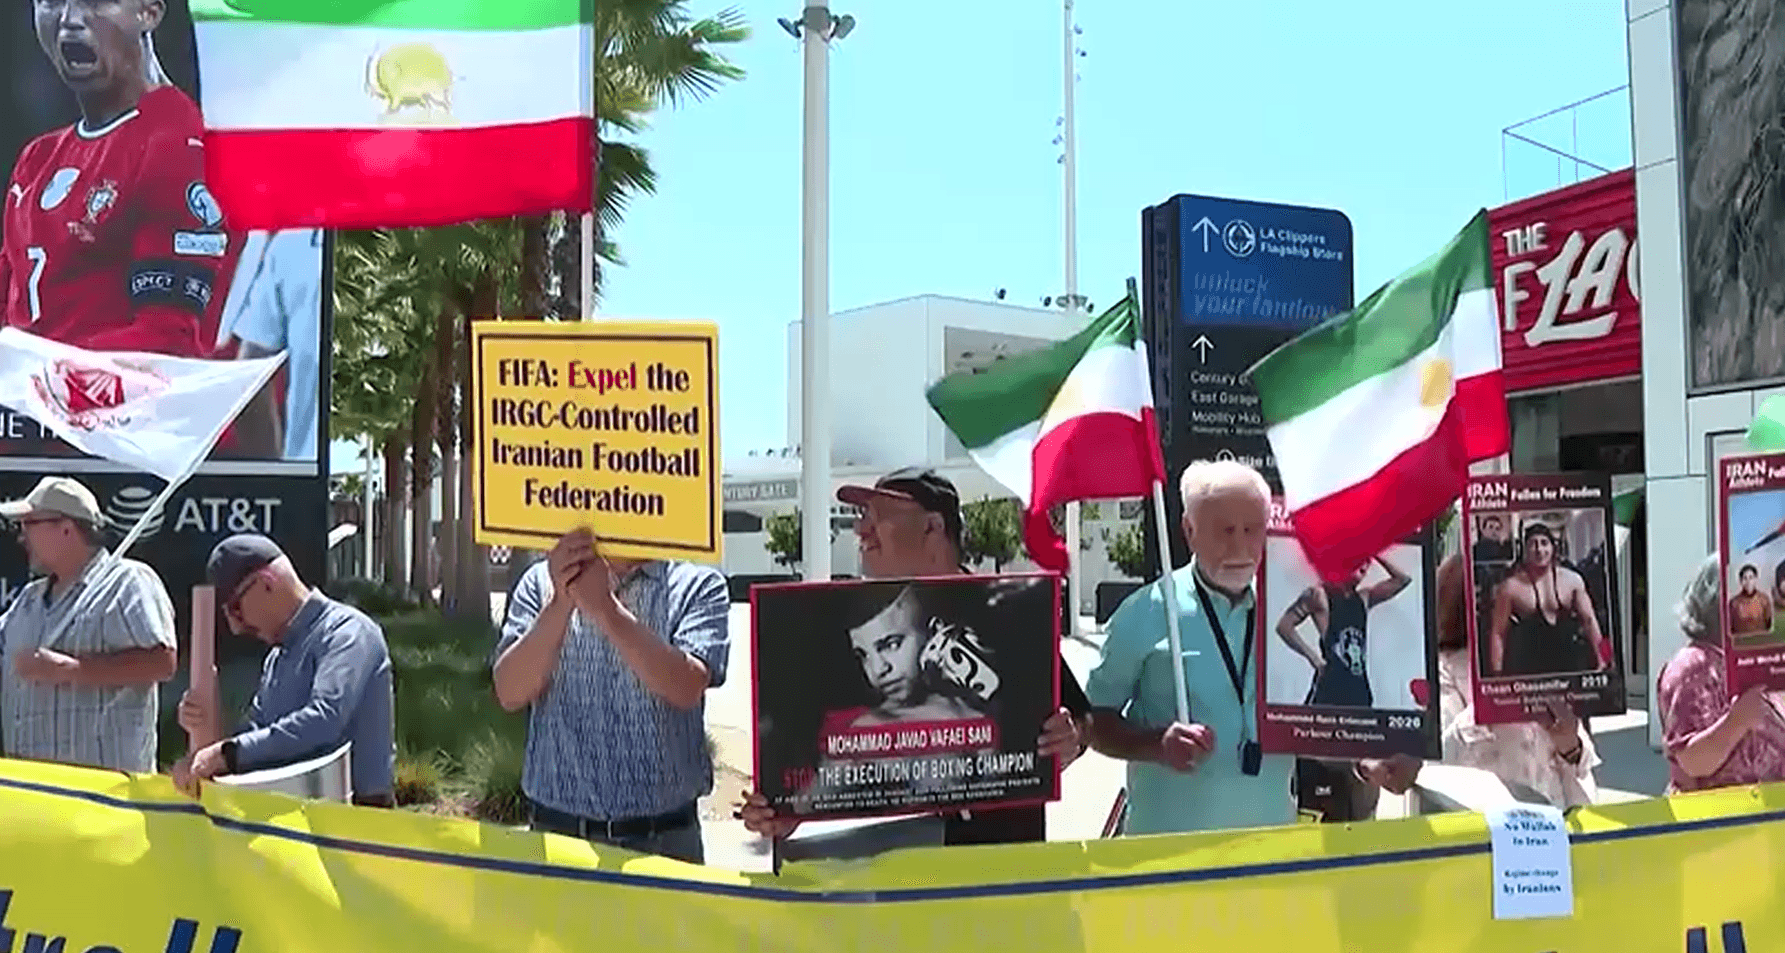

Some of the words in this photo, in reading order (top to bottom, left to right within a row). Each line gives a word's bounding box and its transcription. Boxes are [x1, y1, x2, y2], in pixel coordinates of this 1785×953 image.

[1259, 227, 1275, 240] LA
[1277, 230, 1325, 245] Clippers
[1260, 242, 1310, 258] Flagship
[1502, 221, 1550, 257] THE
[499, 358, 559, 388] FIFA:
[568, 360, 637, 396] Expel
[646, 361, 691, 393] the
[1190, 370, 1237, 387] Century
[1190, 389, 1217, 403] East
[491, 396, 700, 436] IRGC-Controlled
[1192, 410, 1237, 425] Mobility
[491, 436, 583, 470] Iranian
[592, 441, 700, 478] Football
[1726, 460, 1767, 478] IRAN
[524, 477, 665, 517] Federation
[1467, 482, 1509, 499] IRAN
[174, 497, 282, 533] AT&T
[827, 732, 892, 755] MOHAMMAD
[894, 730, 927, 751] JAVAD
[929, 728, 966, 748] VAFAEI
[967, 725, 992, 746] SANI
[818, 765, 841, 788] THE
[845, 760, 910, 786] EXECUTION
[912, 760, 928, 780] OF
[929, 756, 974, 779] BOXING
[976, 752, 1035, 774] CHAMPION
